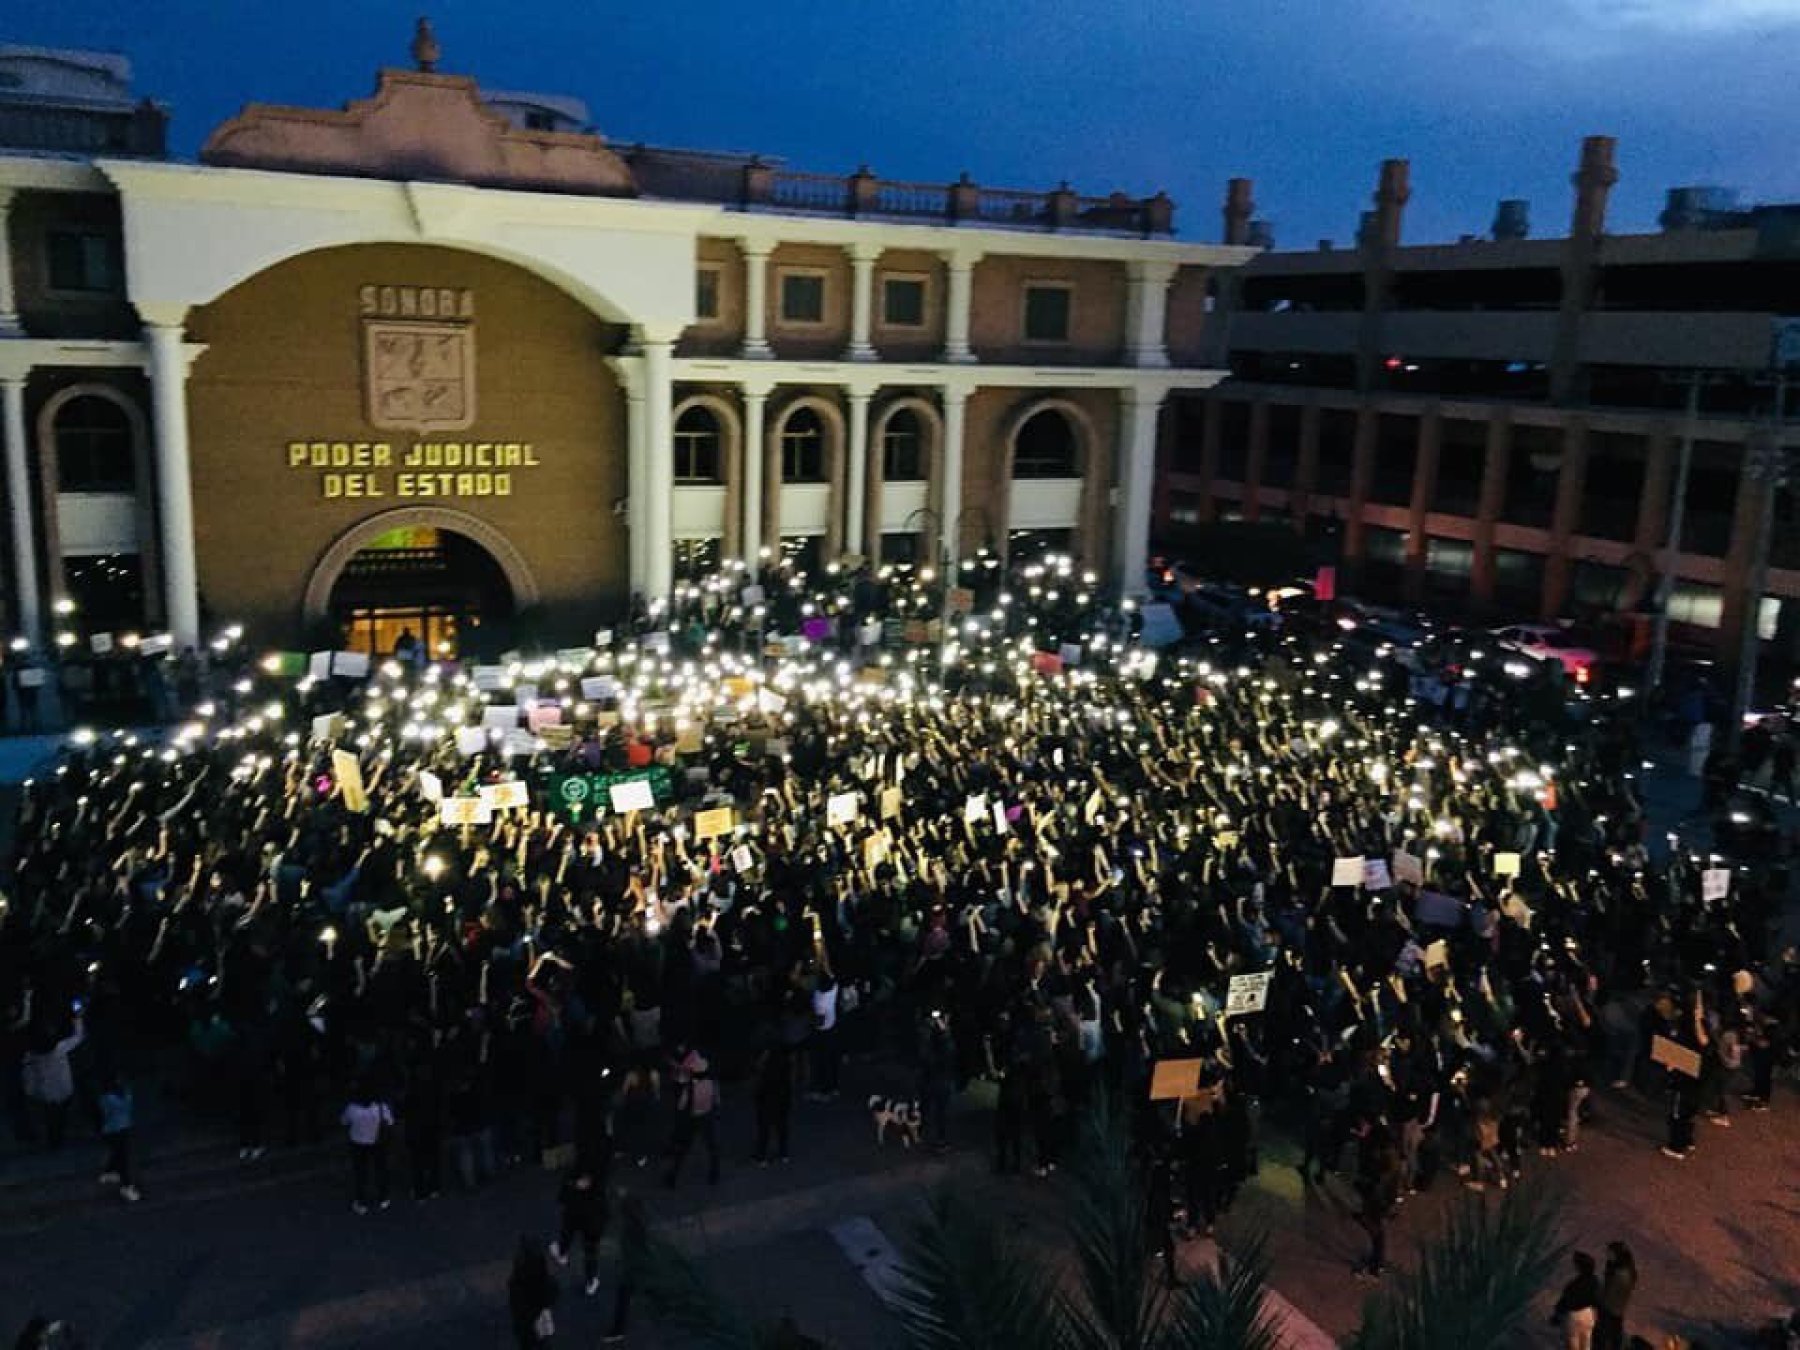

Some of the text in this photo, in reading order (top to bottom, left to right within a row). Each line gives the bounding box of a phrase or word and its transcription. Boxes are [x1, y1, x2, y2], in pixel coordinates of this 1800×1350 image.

[360, 286, 474, 316] SONORA
[289, 443, 541, 467] PODER JUDICIAL
[324, 473, 511, 498] DEL ESTADO
